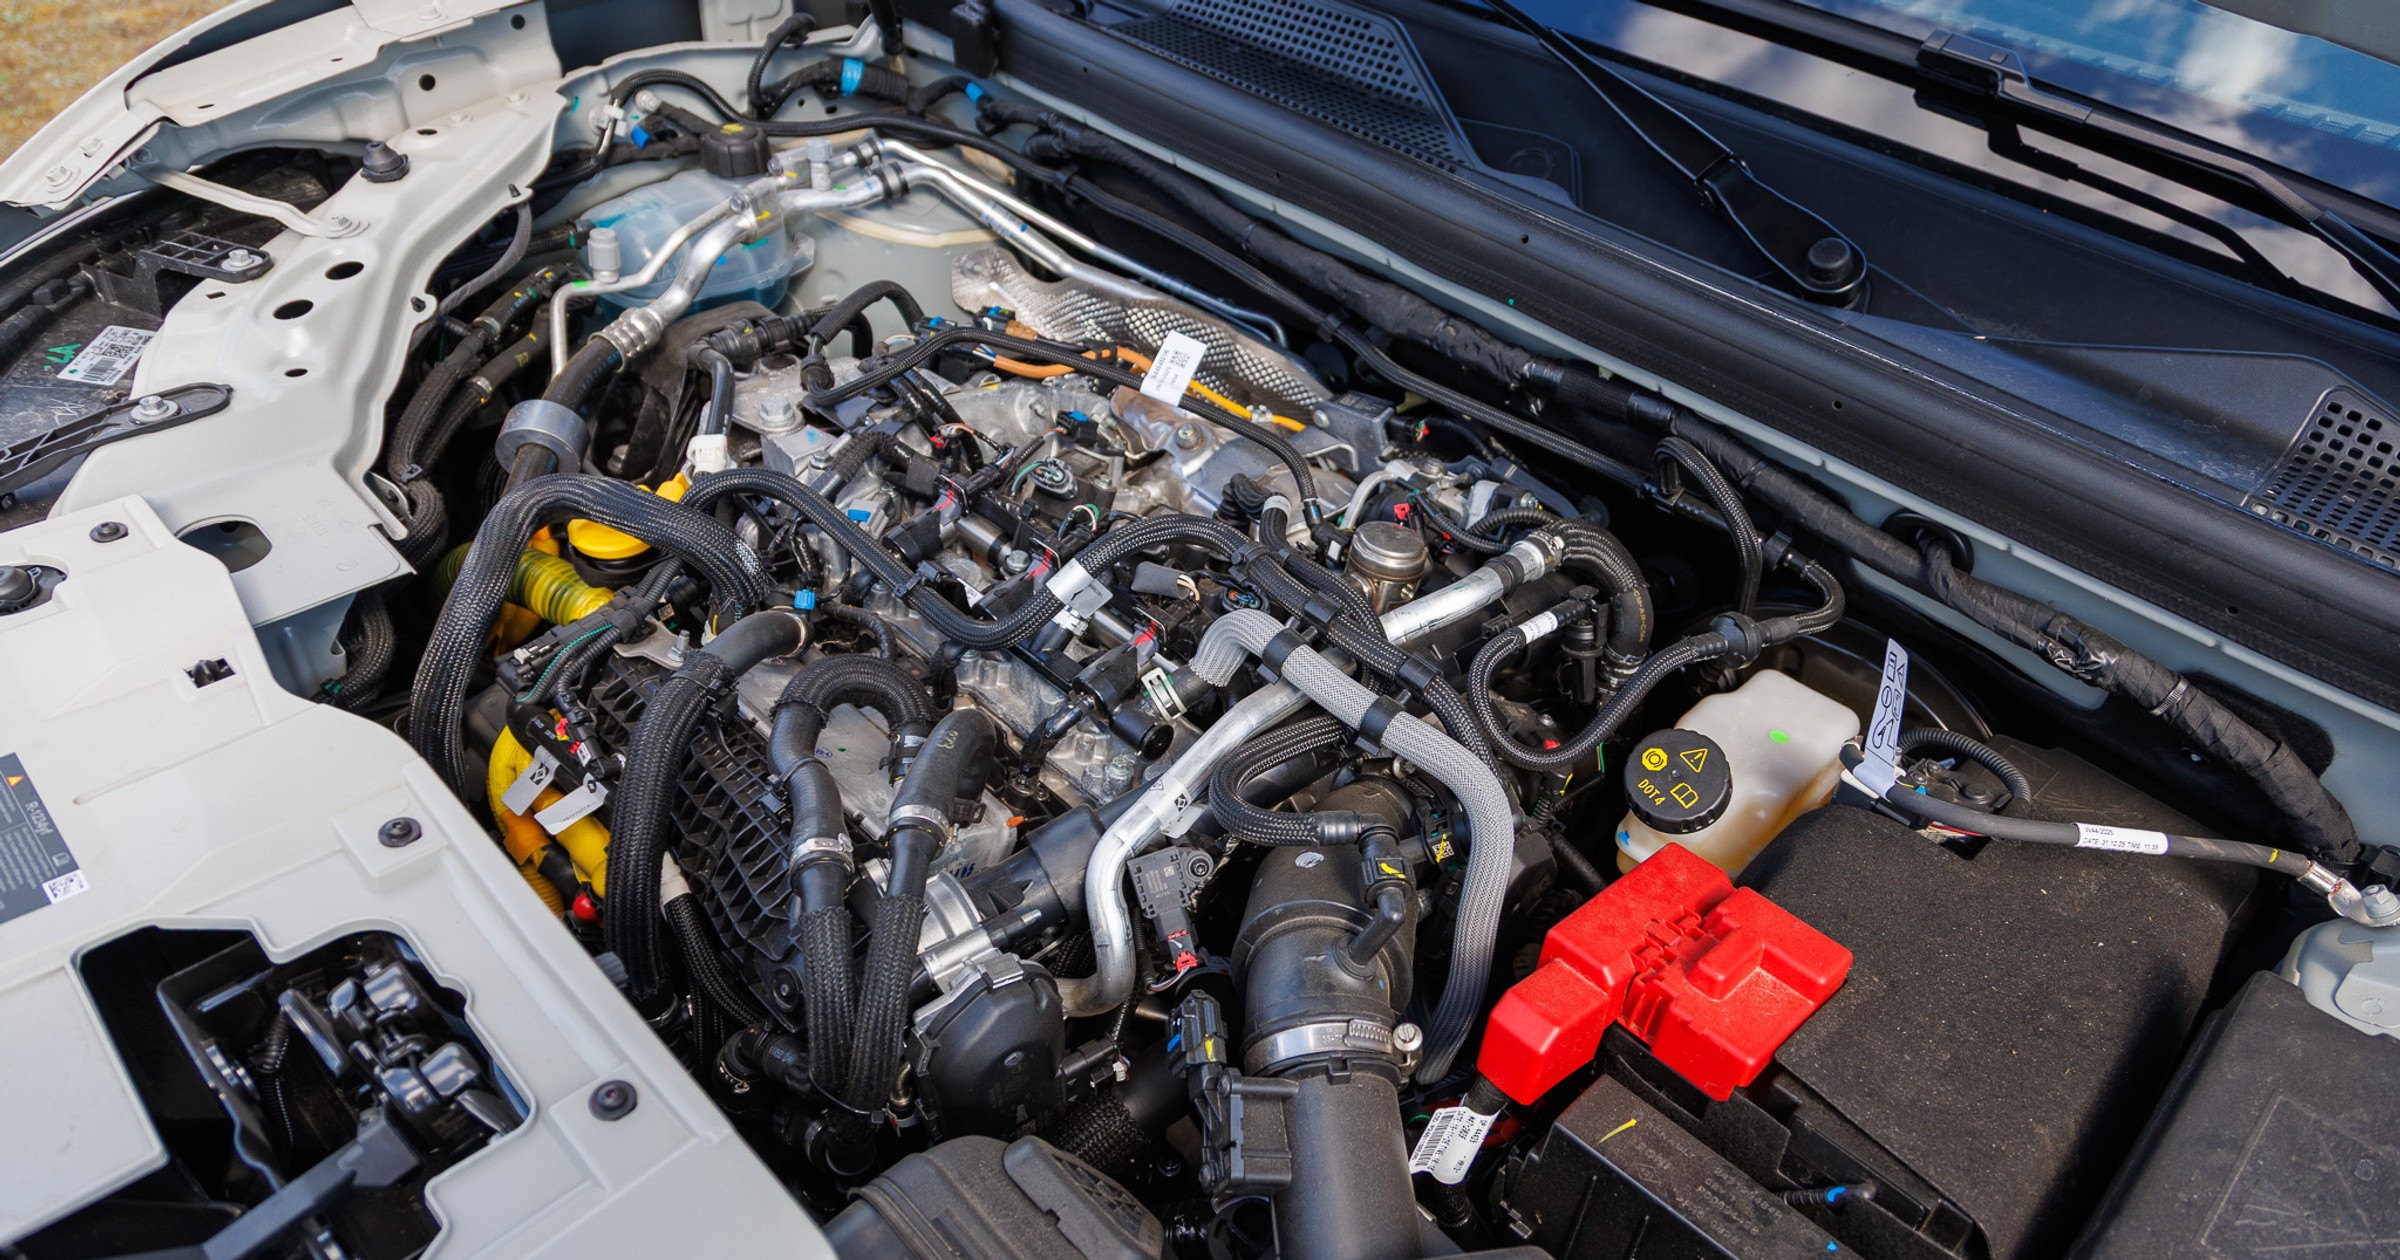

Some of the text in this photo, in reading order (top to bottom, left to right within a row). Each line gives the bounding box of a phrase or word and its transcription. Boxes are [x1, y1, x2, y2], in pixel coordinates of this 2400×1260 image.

[1638, 779, 1666, 806] DOT 4
[25, 800, 54, 836] R-1234yf
